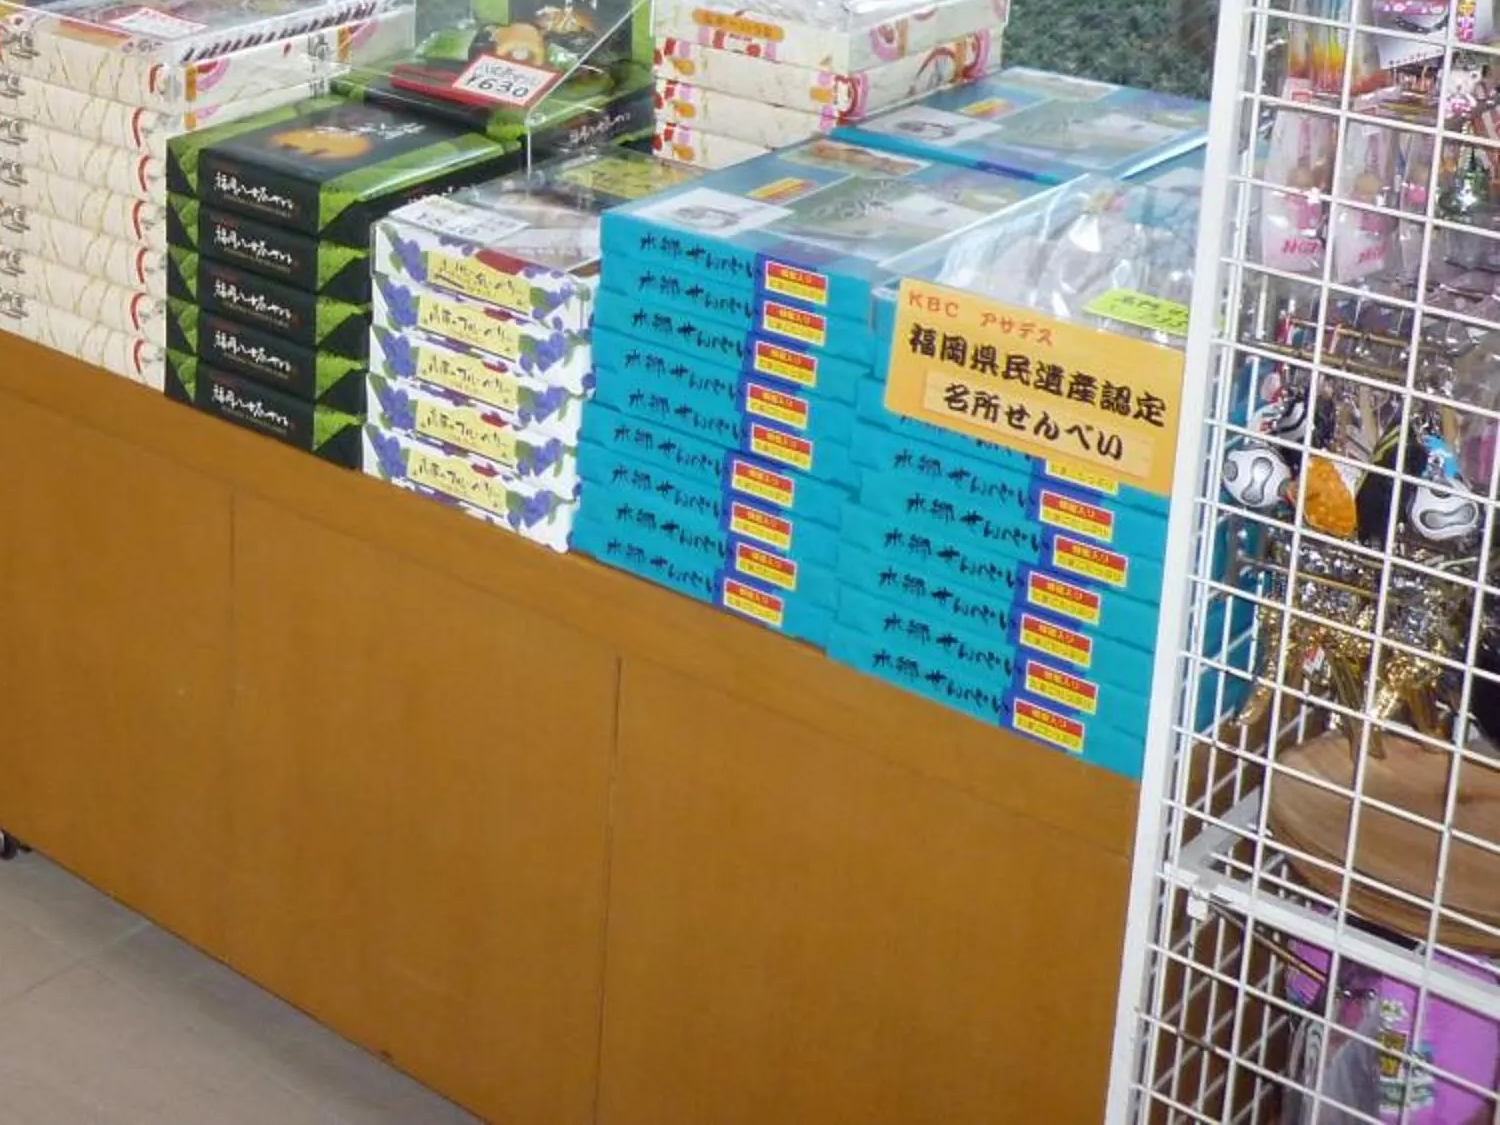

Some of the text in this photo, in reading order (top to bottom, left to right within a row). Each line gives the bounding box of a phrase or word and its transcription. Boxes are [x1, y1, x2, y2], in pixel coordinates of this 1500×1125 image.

[909, 290, 1054, 346] KBC アサデス
[909, 322, 1167, 427] 福岡県民遺産認定
[943, 382, 1123, 461] 名所せんべい
